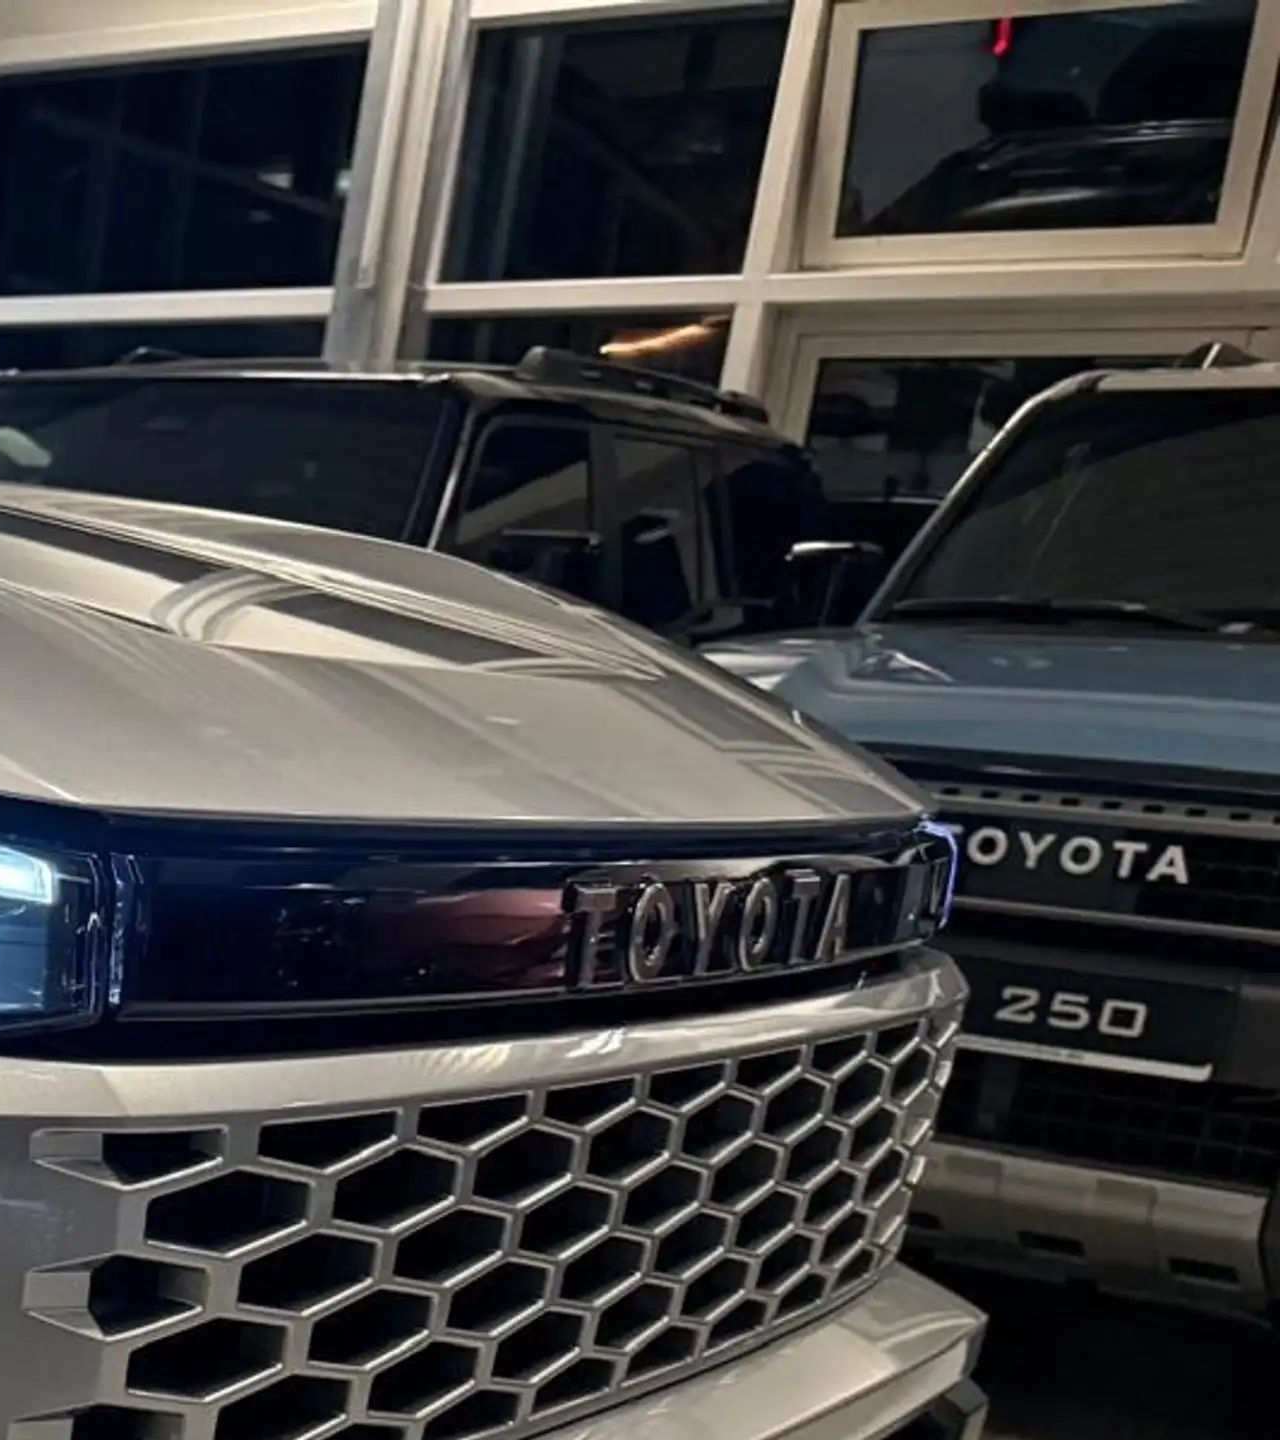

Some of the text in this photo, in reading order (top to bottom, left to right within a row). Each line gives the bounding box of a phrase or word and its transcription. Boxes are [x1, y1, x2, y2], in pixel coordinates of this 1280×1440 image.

[950, 824, 1189, 884] OYOTA
[566, 868, 851, 989] TOYOTA
[994, 986, 1147, 1037] 250
